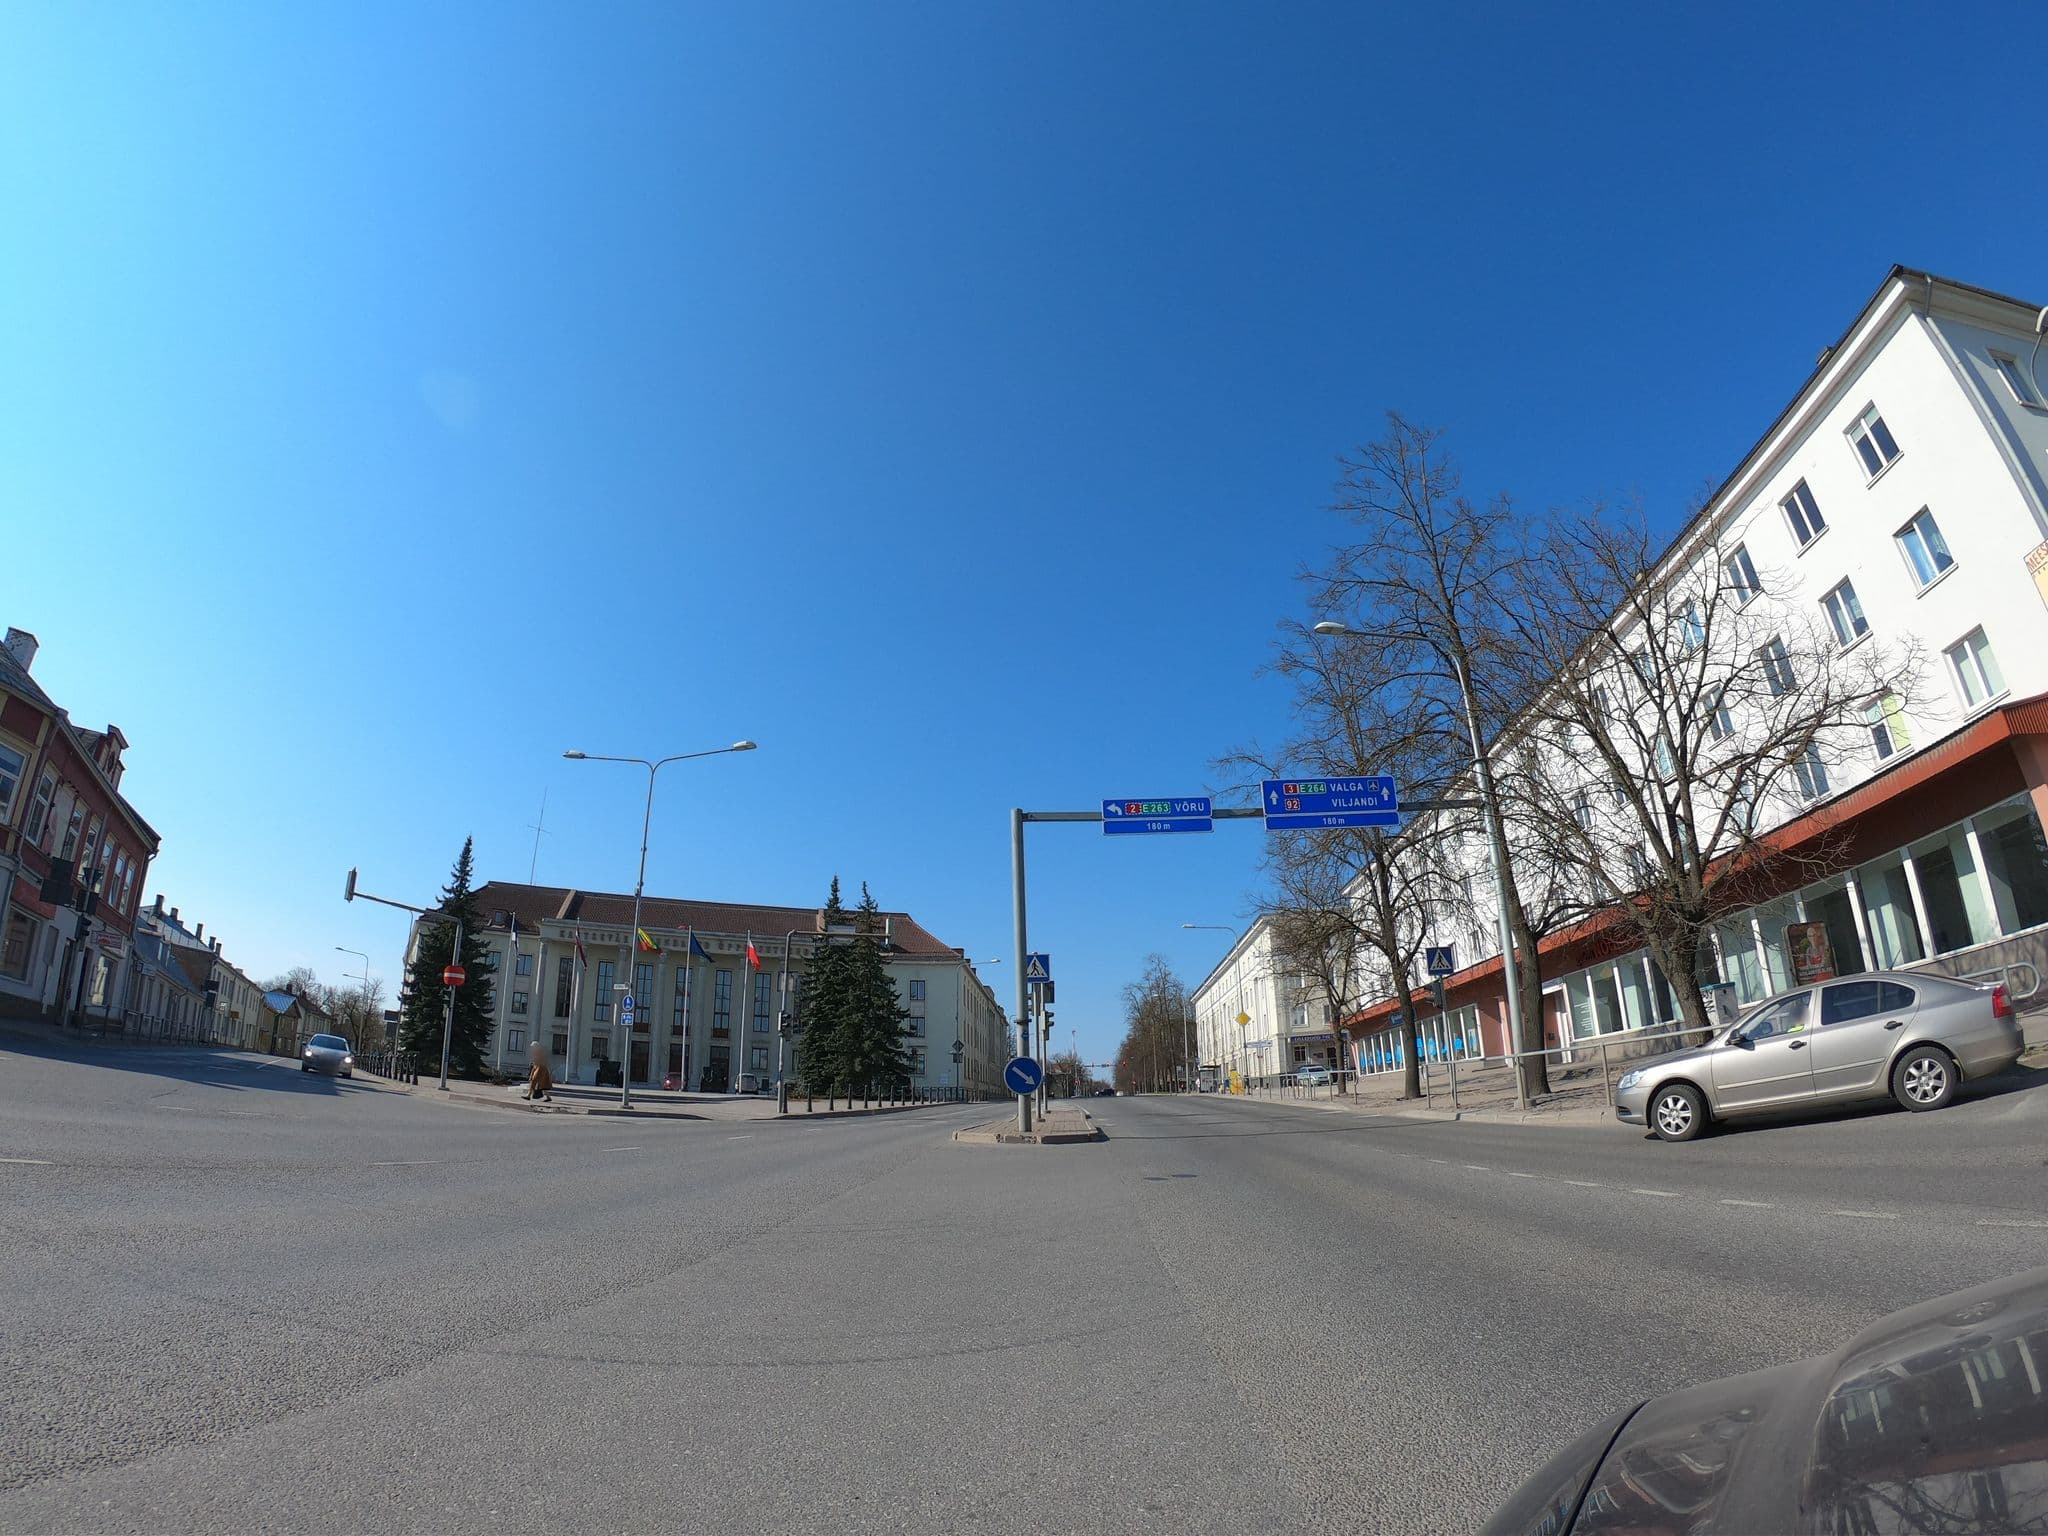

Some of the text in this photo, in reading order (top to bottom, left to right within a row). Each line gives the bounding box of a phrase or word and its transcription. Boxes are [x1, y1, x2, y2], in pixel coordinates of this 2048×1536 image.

[1288, 785, 1294, 793] 3
[1300, 785, 1306, 793] E
[1330, 782, 1364, 792] VALGA
[1130, 804, 1136, 813] 2
[1142, 804, 1149, 813] E
[1175, 801, 1204, 812] VÕRU
[1286, 797, 1378, 809] 92 VILJANDI
[1147, 822, 1161, 830] 180
[1323, 817, 1337, 825] 180
